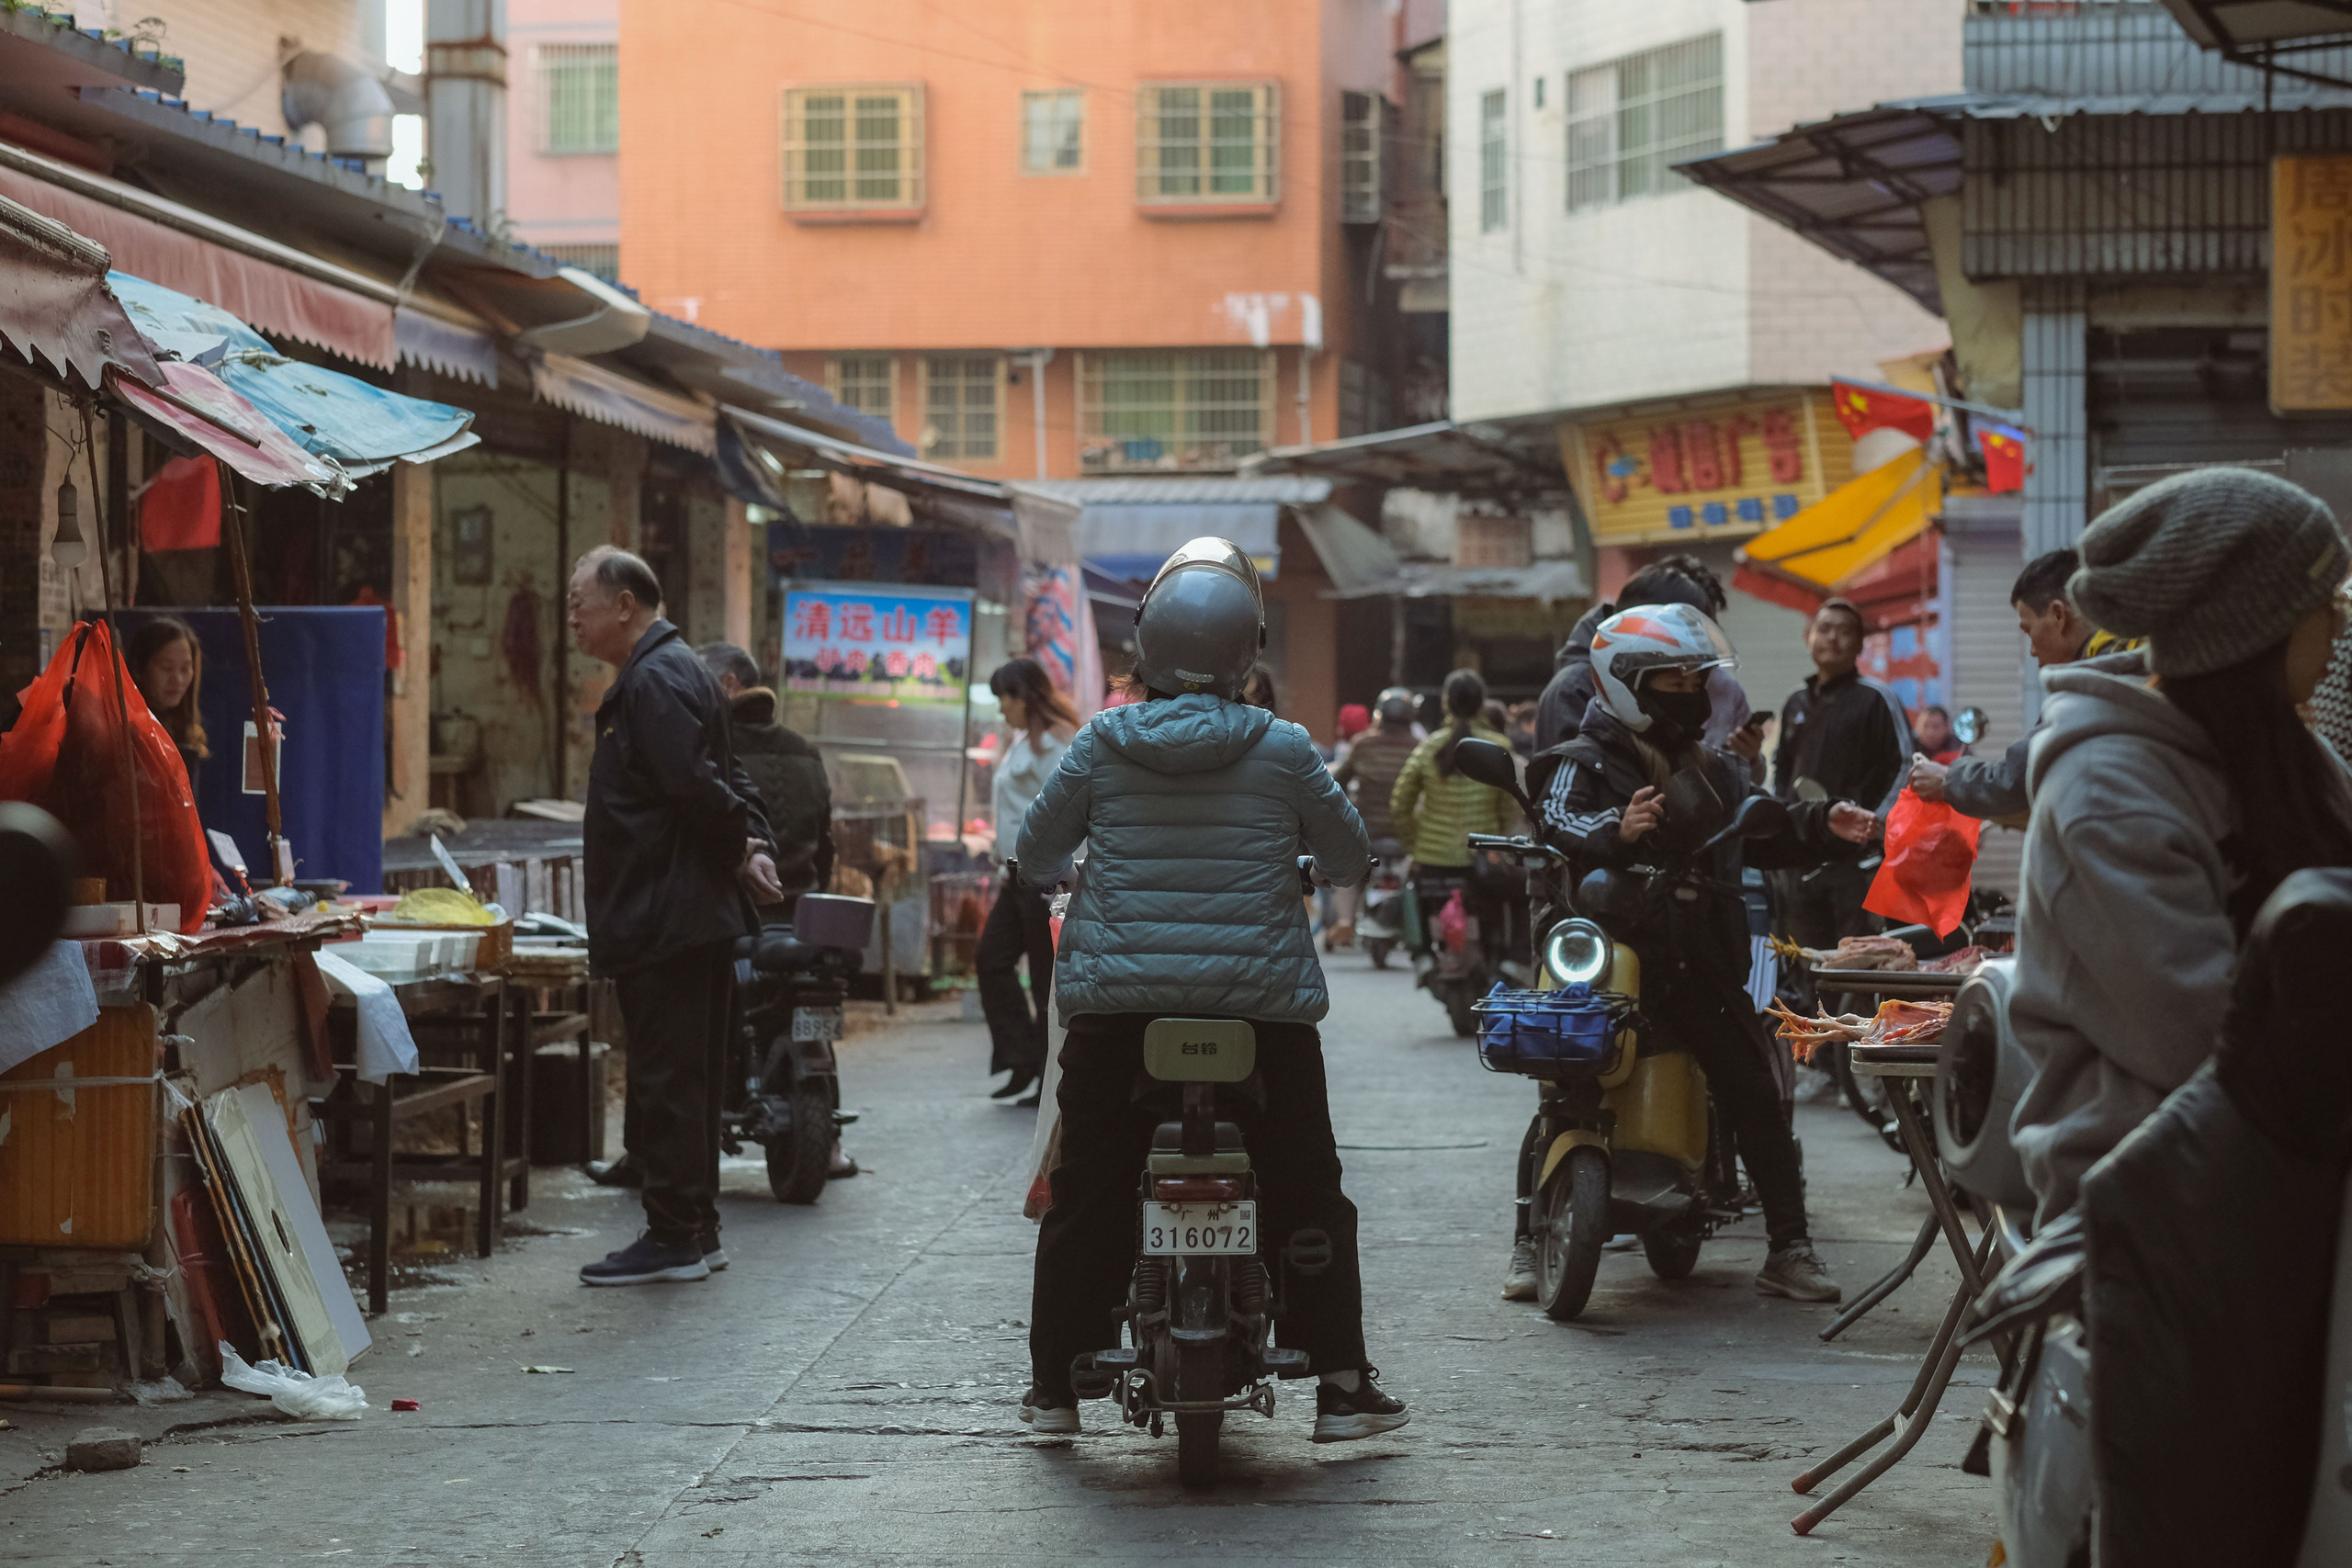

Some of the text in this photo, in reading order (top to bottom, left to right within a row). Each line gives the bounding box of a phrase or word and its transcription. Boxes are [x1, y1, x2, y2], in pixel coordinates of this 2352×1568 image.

[795, 600, 960, 646] 清远山羊
[1182, 1042, 1217, 1055] 台铃
[1181, 1209, 1220, 1222] 广州
[1150, 1226, 1250, 1248] 316072
